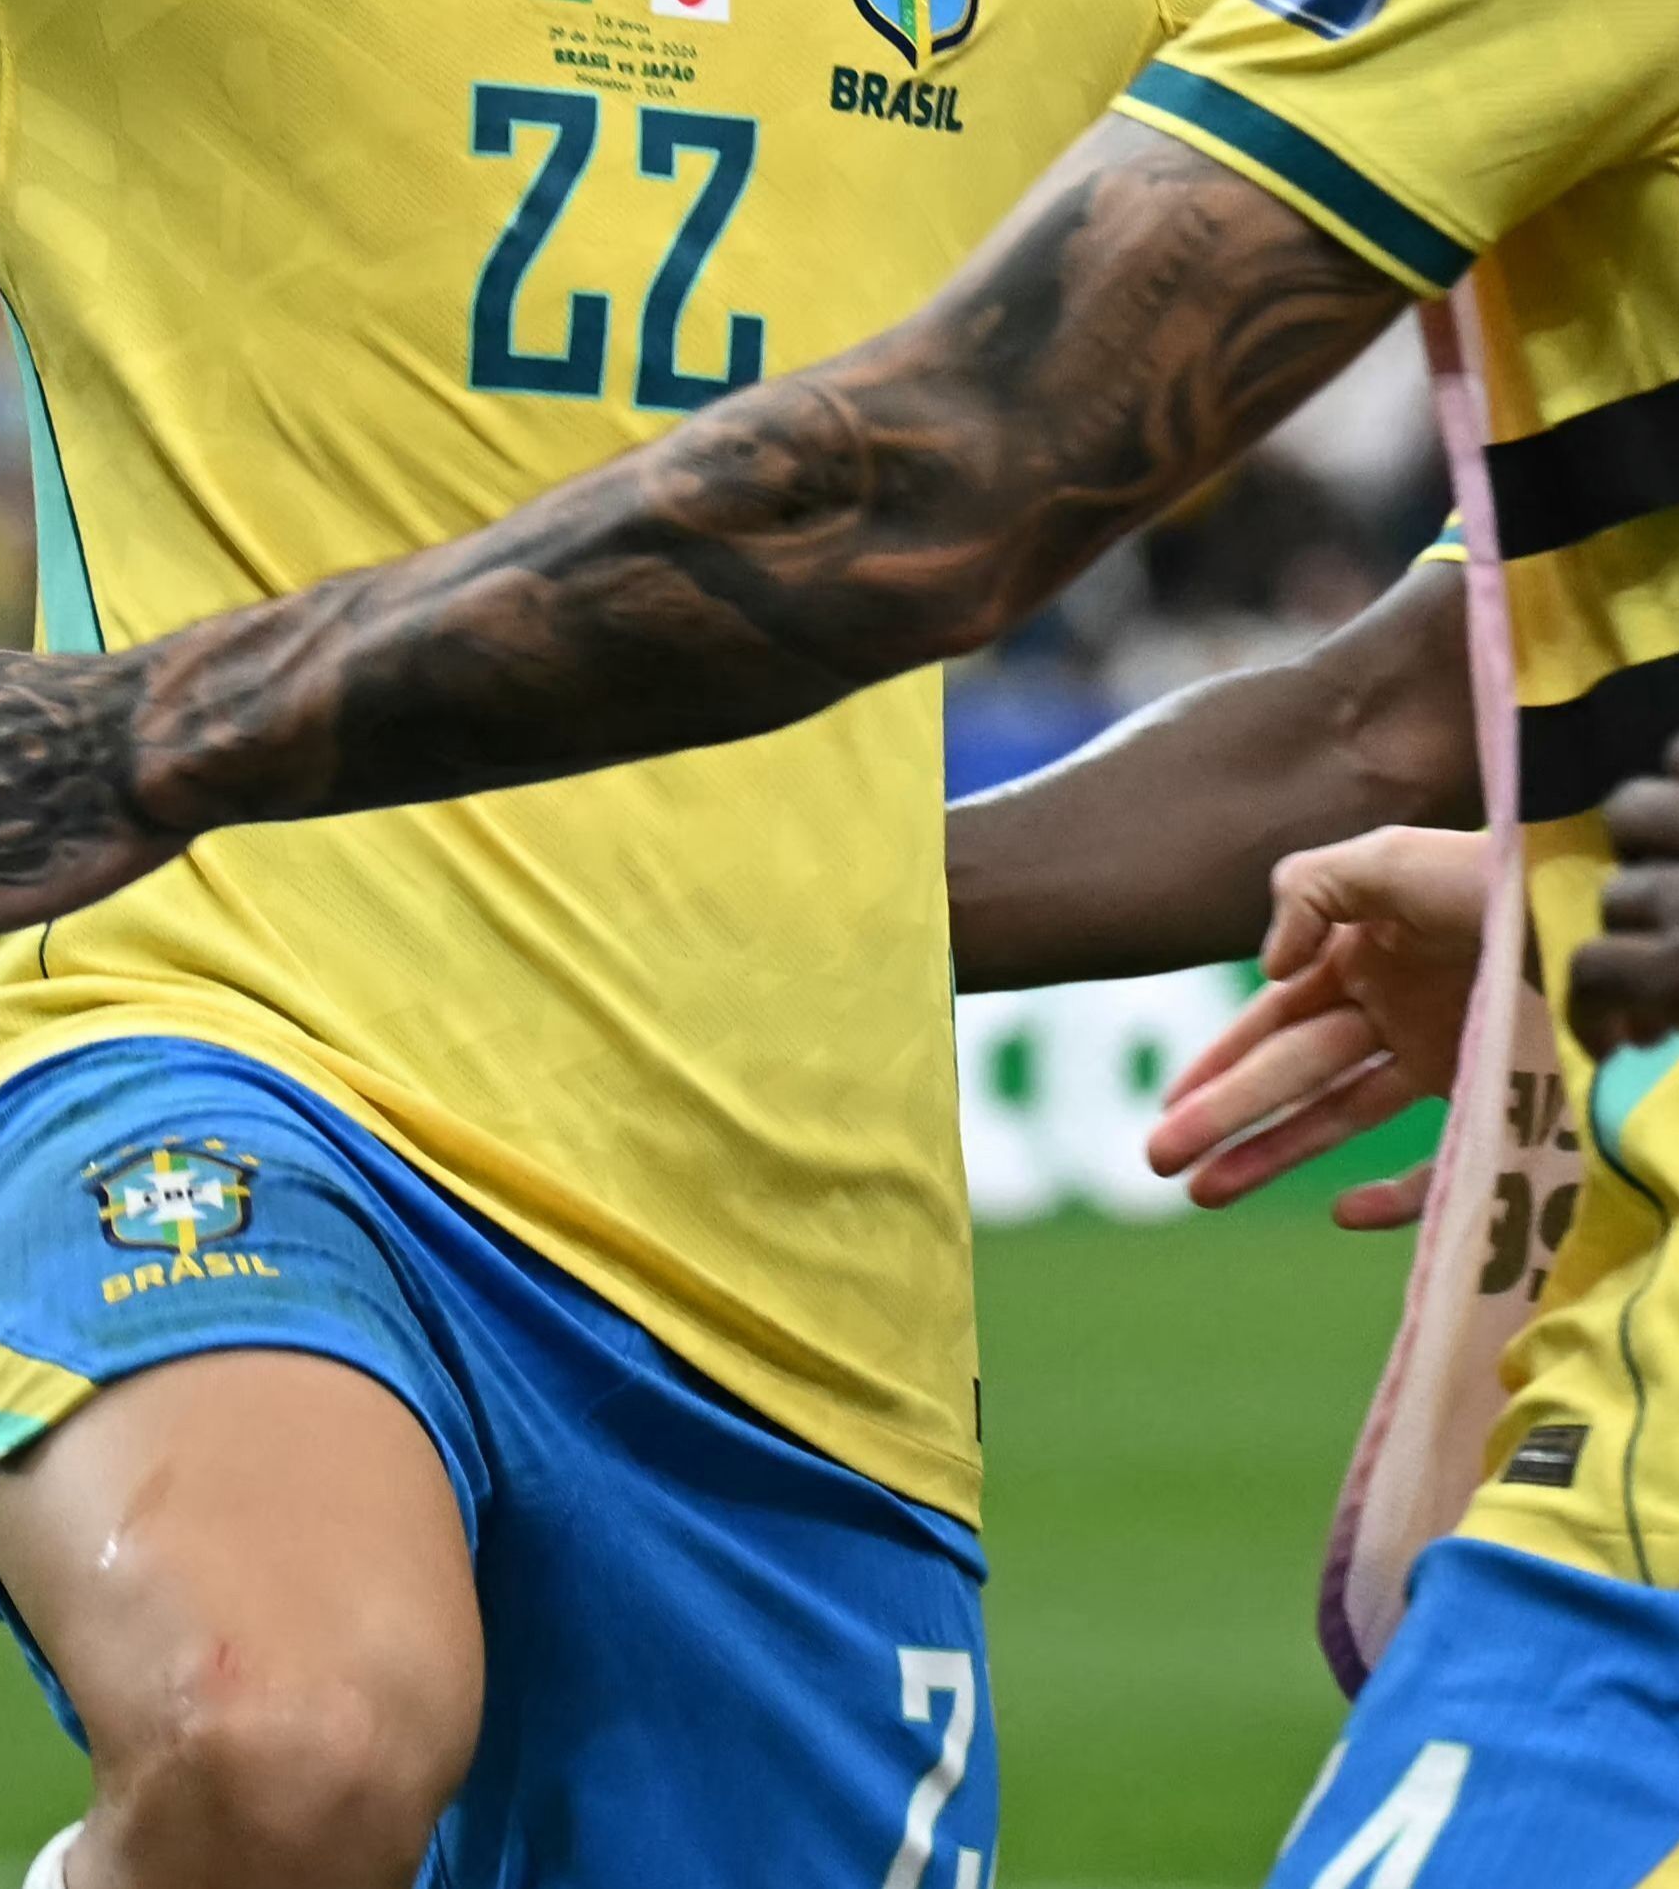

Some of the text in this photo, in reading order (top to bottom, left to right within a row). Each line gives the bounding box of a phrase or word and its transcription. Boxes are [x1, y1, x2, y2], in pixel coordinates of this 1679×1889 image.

[554, 49, 610, 69] BRASIL
[642, 62, 695, 82] JAPÃO
[829, 64, 963, 132] BRASIL
[470, 81, 766, 413] 22
[101, 1252, 280, 1304] BRASIL
